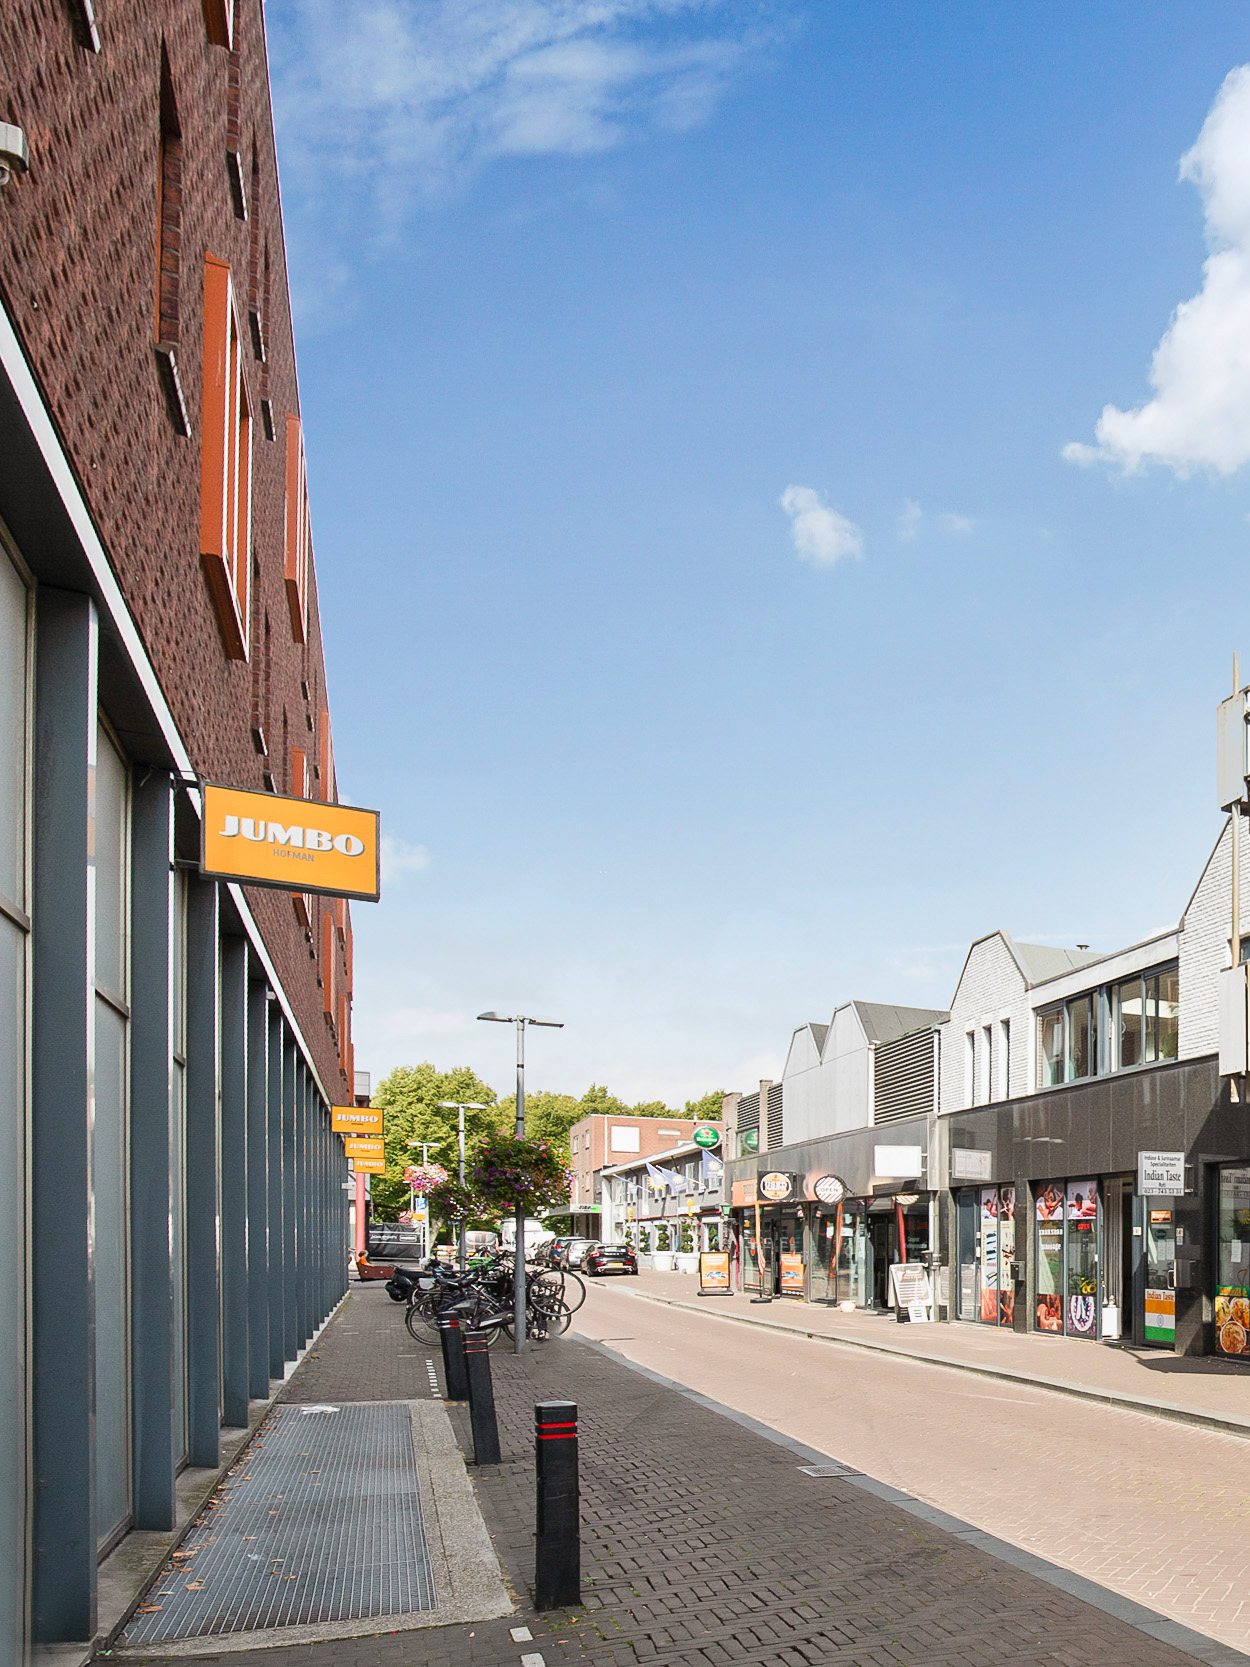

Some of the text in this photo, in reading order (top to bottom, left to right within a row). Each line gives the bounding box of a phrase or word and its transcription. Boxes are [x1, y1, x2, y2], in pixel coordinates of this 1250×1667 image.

[218, 815, 365, 857] JUMBO
[273, 848, 315, 862] HOFMAN
[336, 1113, 379, 1123] JUMBO
[1144, 1169, 1182, 1182] Indian Taste
[1146, 1290, 1161, 1300] Indian
